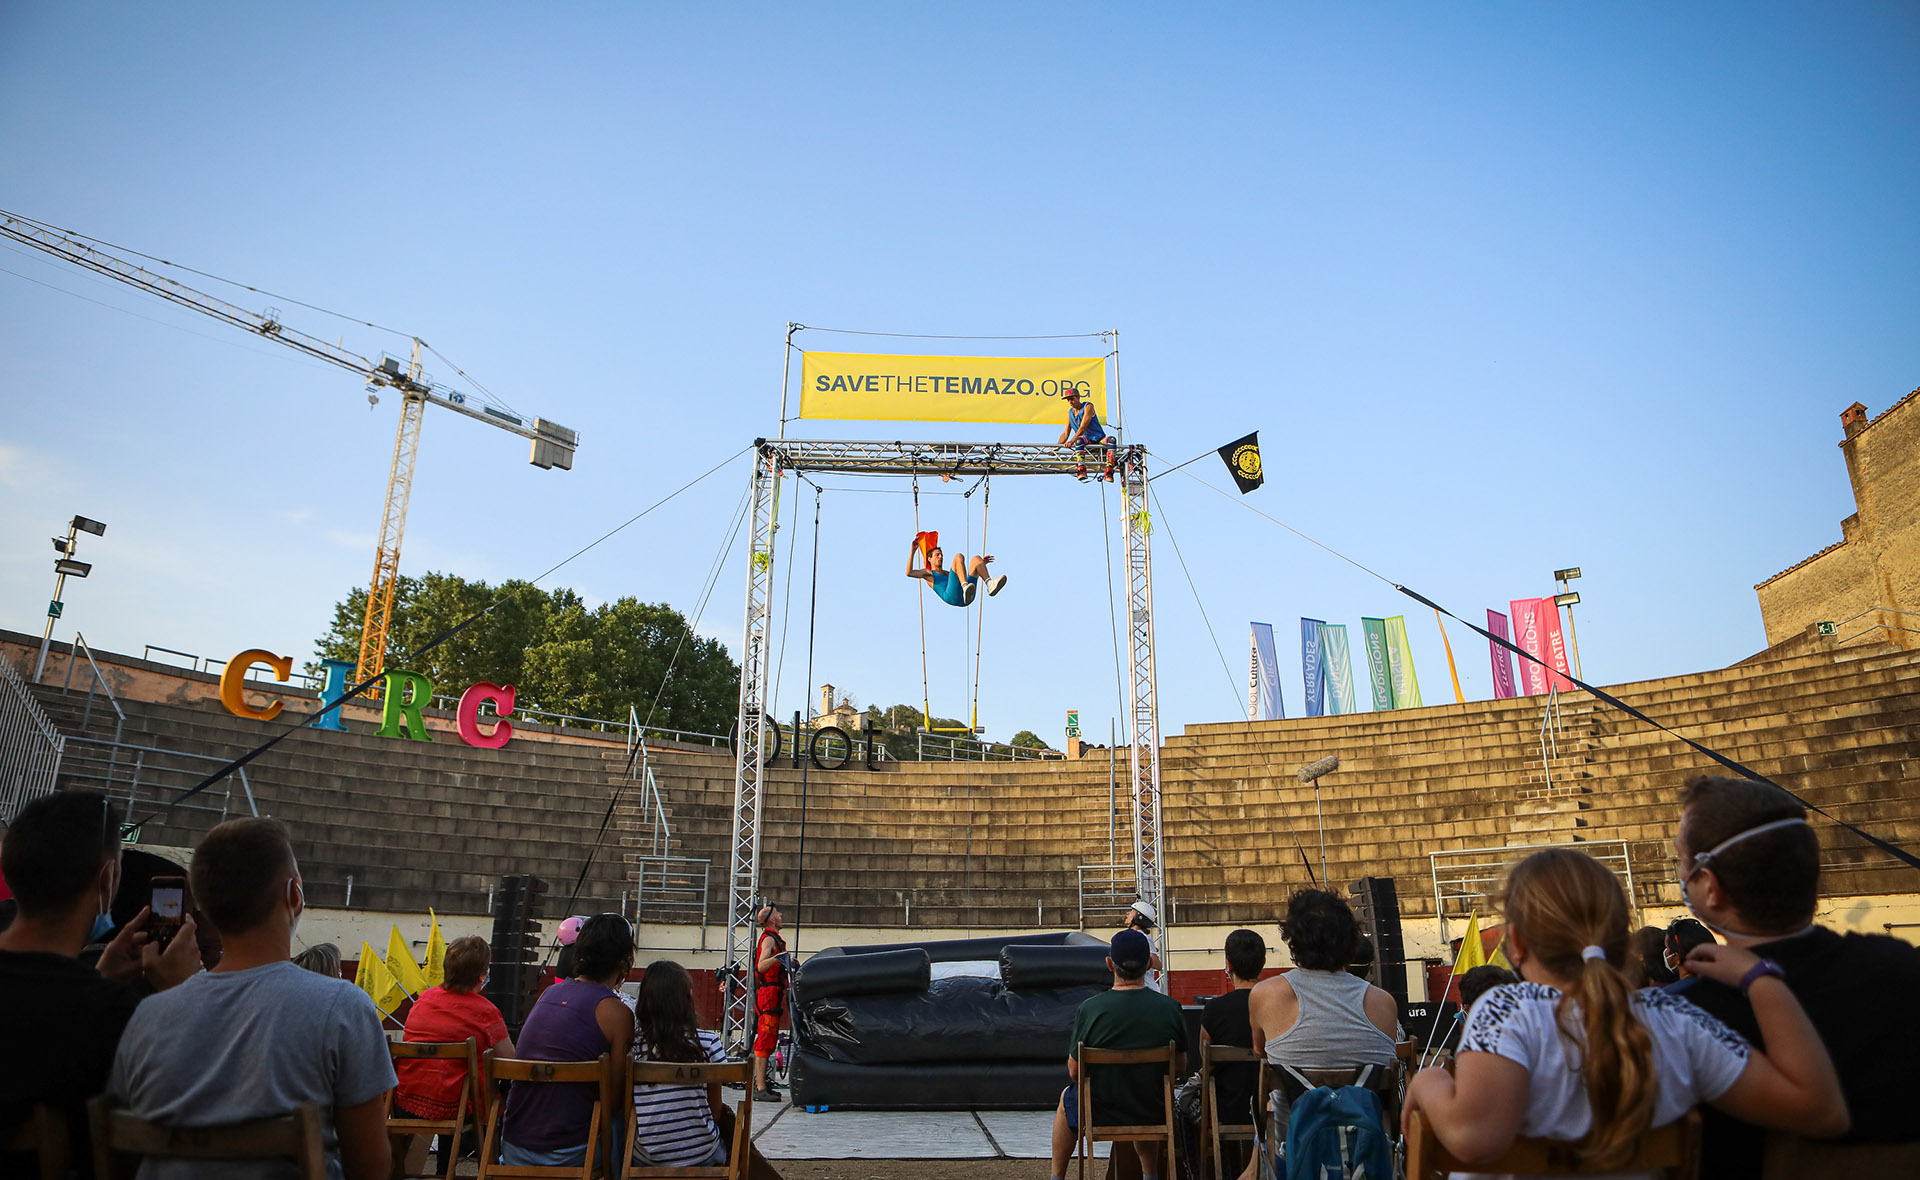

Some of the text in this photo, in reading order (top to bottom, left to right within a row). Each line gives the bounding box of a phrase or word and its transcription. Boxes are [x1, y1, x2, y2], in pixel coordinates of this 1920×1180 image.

[815, 374, 1091, 398] SAVETHETEMAZO.ORG
[1249, 647, 1258, 688] Cultura
[1550, 629, 1566, 676] TEATRE
[220, 648, 516, 749] CIRC
[728, 711, 882, 771] Olot
